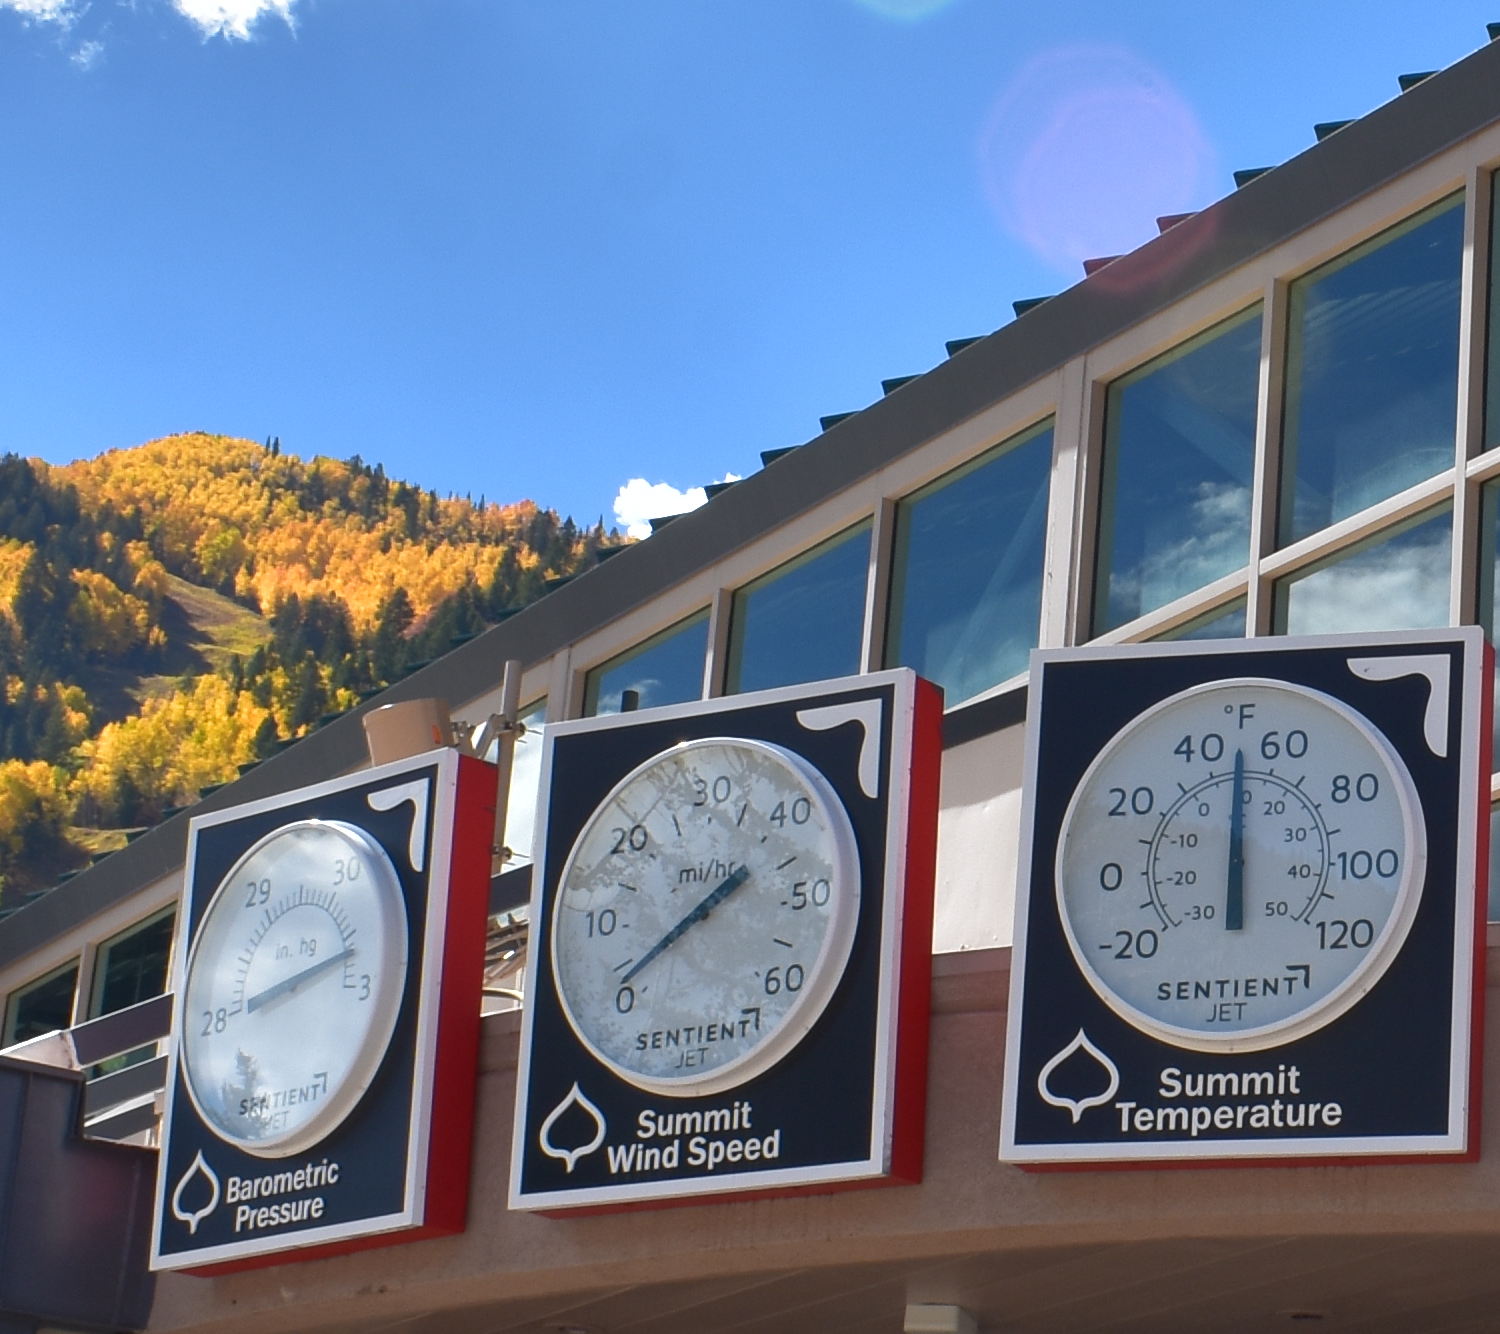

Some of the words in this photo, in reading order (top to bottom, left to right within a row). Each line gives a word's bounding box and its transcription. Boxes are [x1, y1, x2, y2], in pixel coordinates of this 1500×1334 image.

[1173, 732, 1225, 763] 40
[1260, 729, 1309, 761] 60
[693, 775, 731, 806] 30
[1107, 785, 1154, 817] 20
[1330, 772, 1380, 804] 80
[769, 796, 811, 829] 40
[1197, 801, 1210, 818] 0
[1263, 799, 1286, 816] 20
[610, 824, 648, 855] 20
[1283, 826, 1307, 843] 30
[333, 856, 361, 886] 30
[1099, 862, 1123, 892] 0
[1287, 863, 1311, 880] 40
[1337, 848, 1399, 881] 100
[245, 878, 271, 909] 29
[791, 877, 831, 911] 50
[1264, 900, 1289, 917] 50
[586, 908, 617, 938] 10
[1315, 918, 1374, 951] 120
[299, 936, 317, 958] hg
[1098, 928, 1159, 960] -20
[764, 963, 805, 995] 60
[1156, 975, 1299, 1001] SENTIENT
[615, 985, 636, 1014] 0
[1205, 1001, 1248, 1023] JET
[200, 1007, 228, 1038] 28
[635, 1018, 751, 1051] SENTIENT
[674, 1046, 710, 1070] JET
[1158, 1063, 1301, 1099] Summit
[636, 1101, 753, 1140] Summit
[1114, 1099, 1343, 1137] Temperature
[607, 1138, 680, 1175] Wind
[686, 1127, 782, 1171] Speed
[225, 1157, 340, 1205] Barometric
[234, 1196, 325, 1234] Pressure
